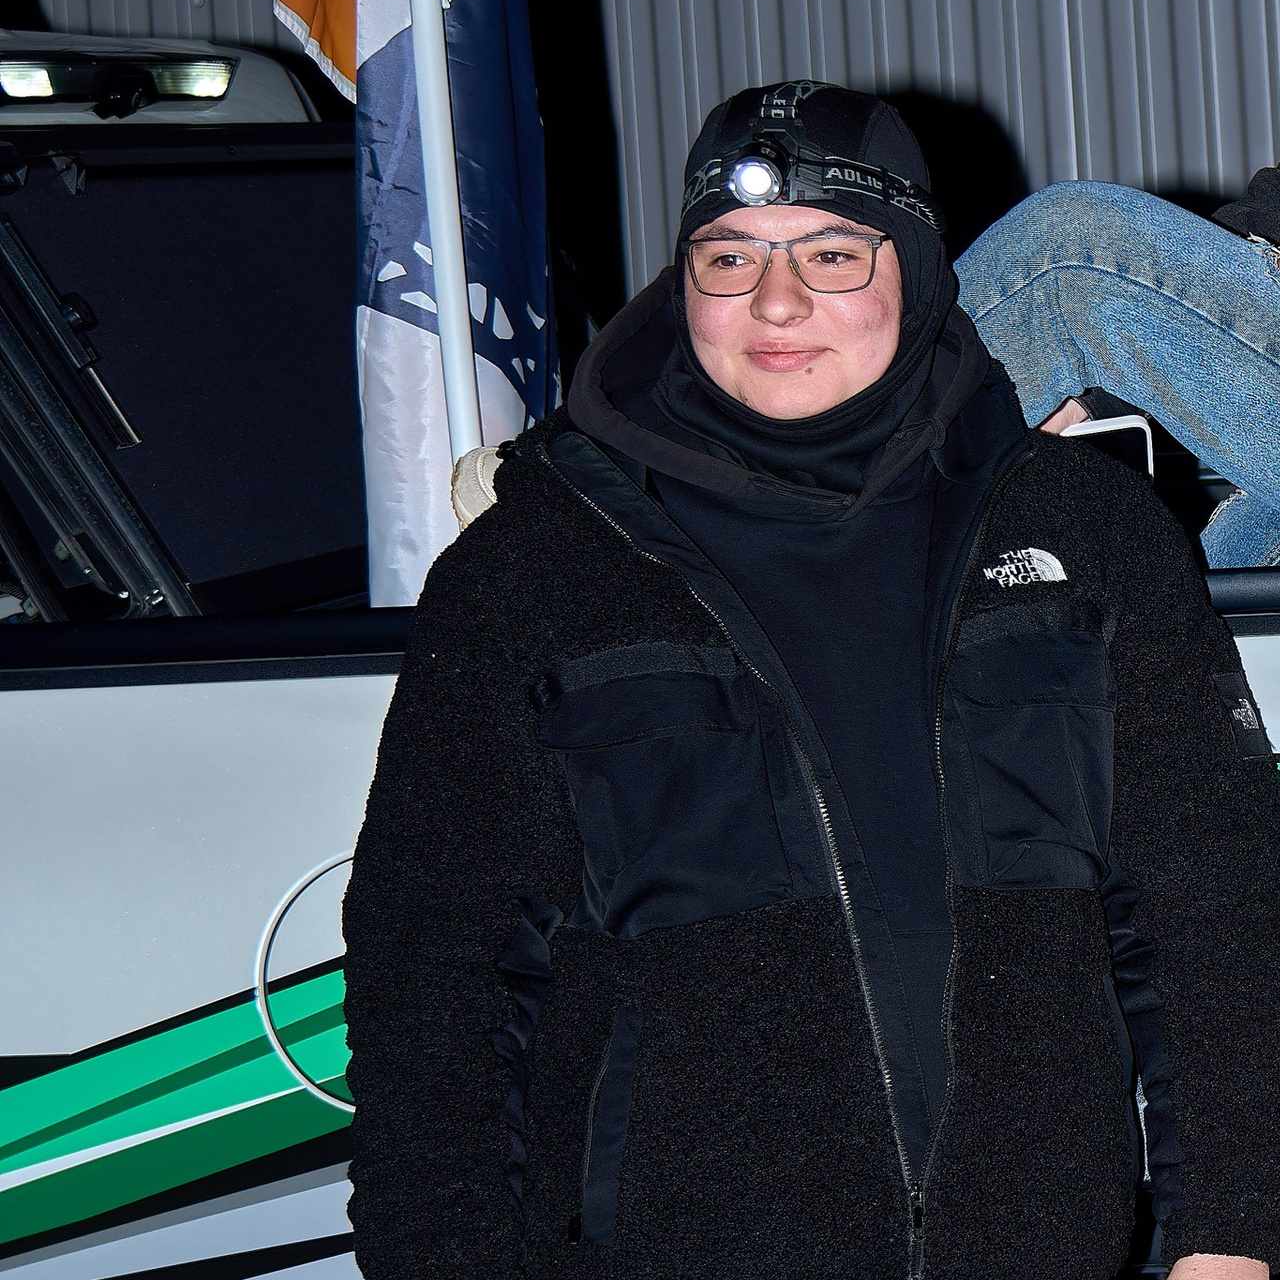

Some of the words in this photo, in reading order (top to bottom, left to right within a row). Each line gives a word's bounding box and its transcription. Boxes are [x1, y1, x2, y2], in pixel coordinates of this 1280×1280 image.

[999, 548, 1033, 564] THE
[983, 559, 1037, 581] NORTH
[998, 571, 1042, 588] FACE
